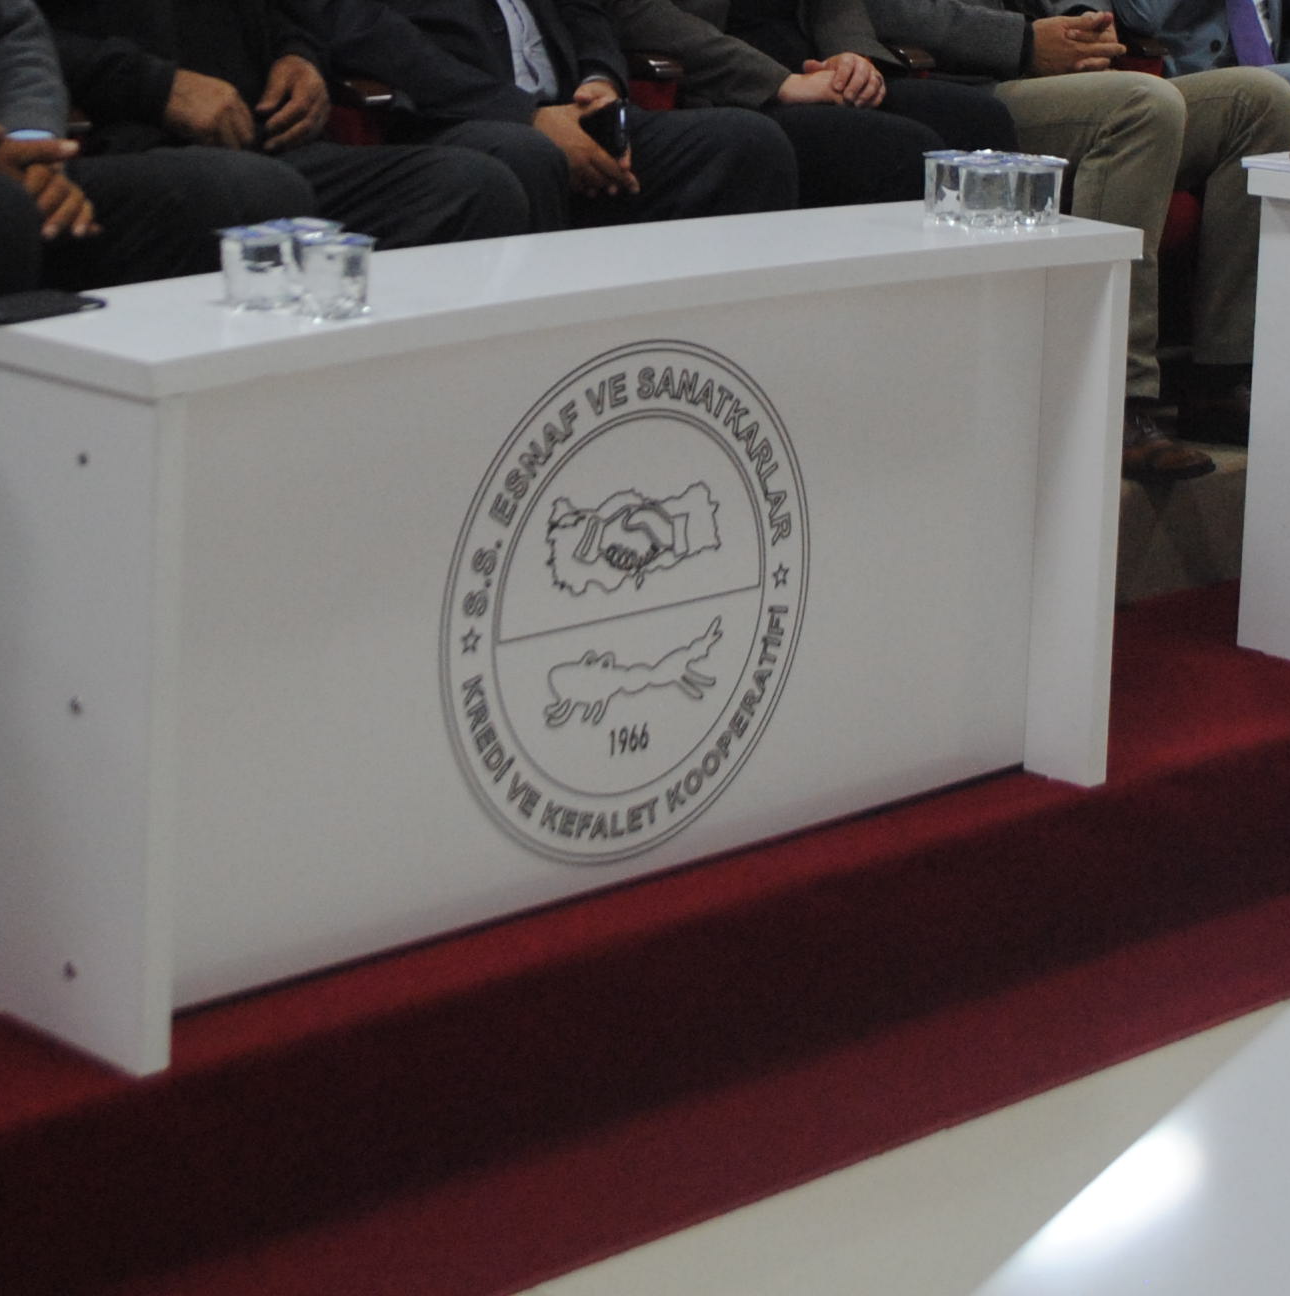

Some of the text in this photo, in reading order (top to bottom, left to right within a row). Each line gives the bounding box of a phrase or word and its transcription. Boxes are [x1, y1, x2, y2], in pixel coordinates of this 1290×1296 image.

[488, 400, 578, 528] ESNAF
[585, 372, 628, 417] VE
[637, 365, 791, 547] SANATKARLAR
[461, 673, 515, 784] KREDİ
[507, 771, 542, 819] VE
[539, 797, 659, 841] KEFALET
[609, 722, 649, 756] 1966
